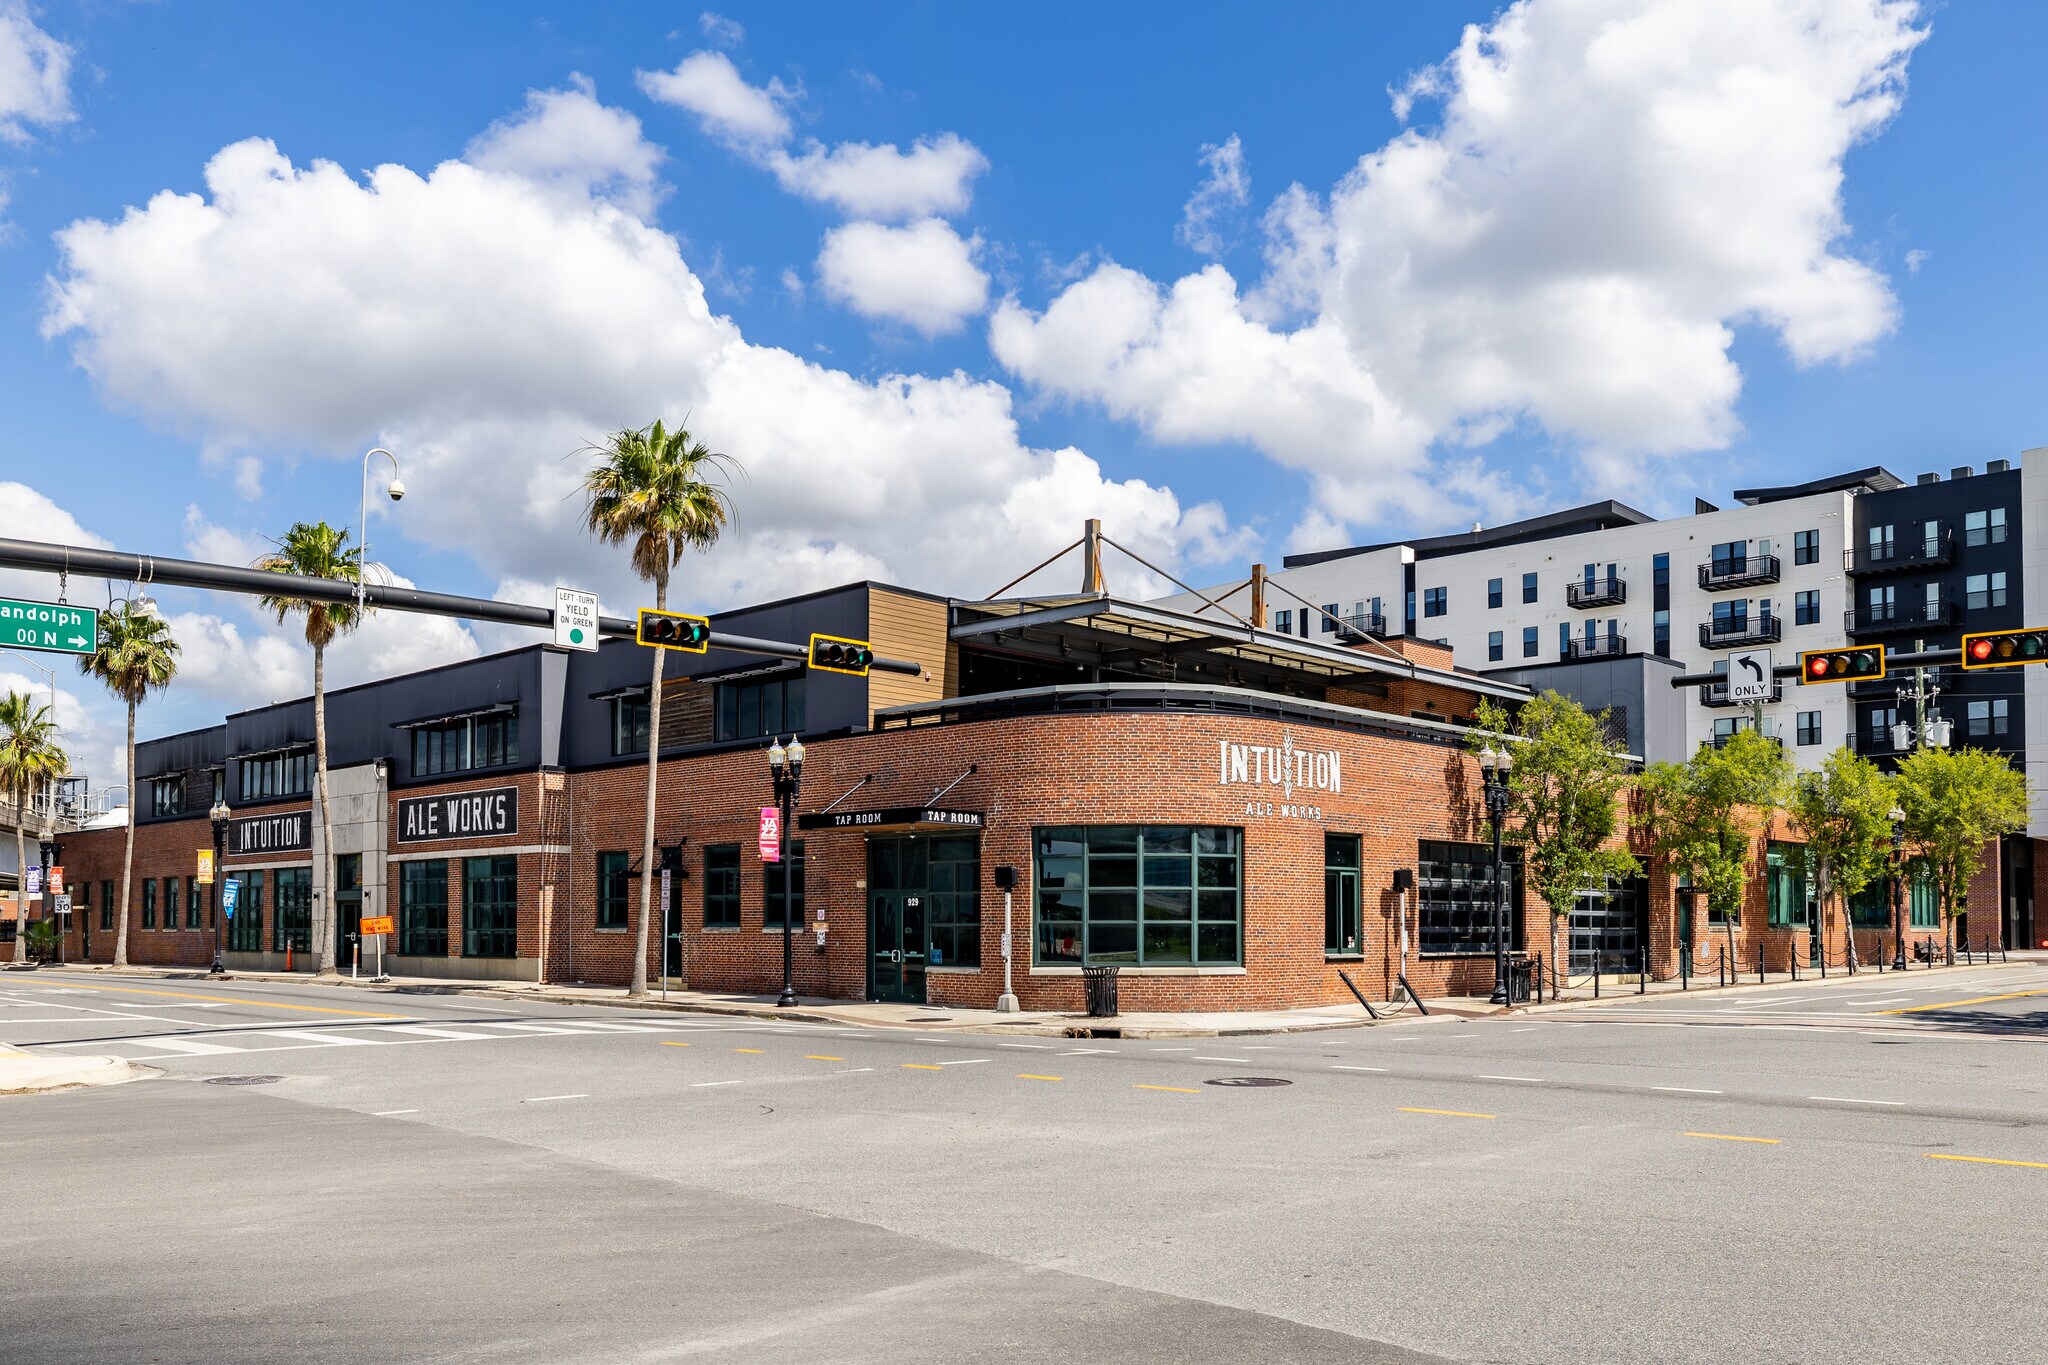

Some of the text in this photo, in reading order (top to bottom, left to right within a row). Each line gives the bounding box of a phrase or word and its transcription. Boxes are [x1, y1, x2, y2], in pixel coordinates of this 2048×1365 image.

[560, 593, 574, 601] LEFT
[566, 604, 588, 616] YIELD
[573, 618, 593, 627] GREEN
[17, 628, 57, 646] 00 N
[1735, 684, 1766, 696] ONLY
[1218, 740, 1341, 793] INTUITION
[406, 795, 506, 836] ALE WORKS
[1245, 802, 1321, 820] ALE WORKS
[835, 813, 882, 825] TAP ROOM
[927, 811, 979, 824] TAP ROOM
[240, 816, 301, 850] INTUITION
[56, 903, 70, 911] 30
[907, 898, 919, 907] 929
